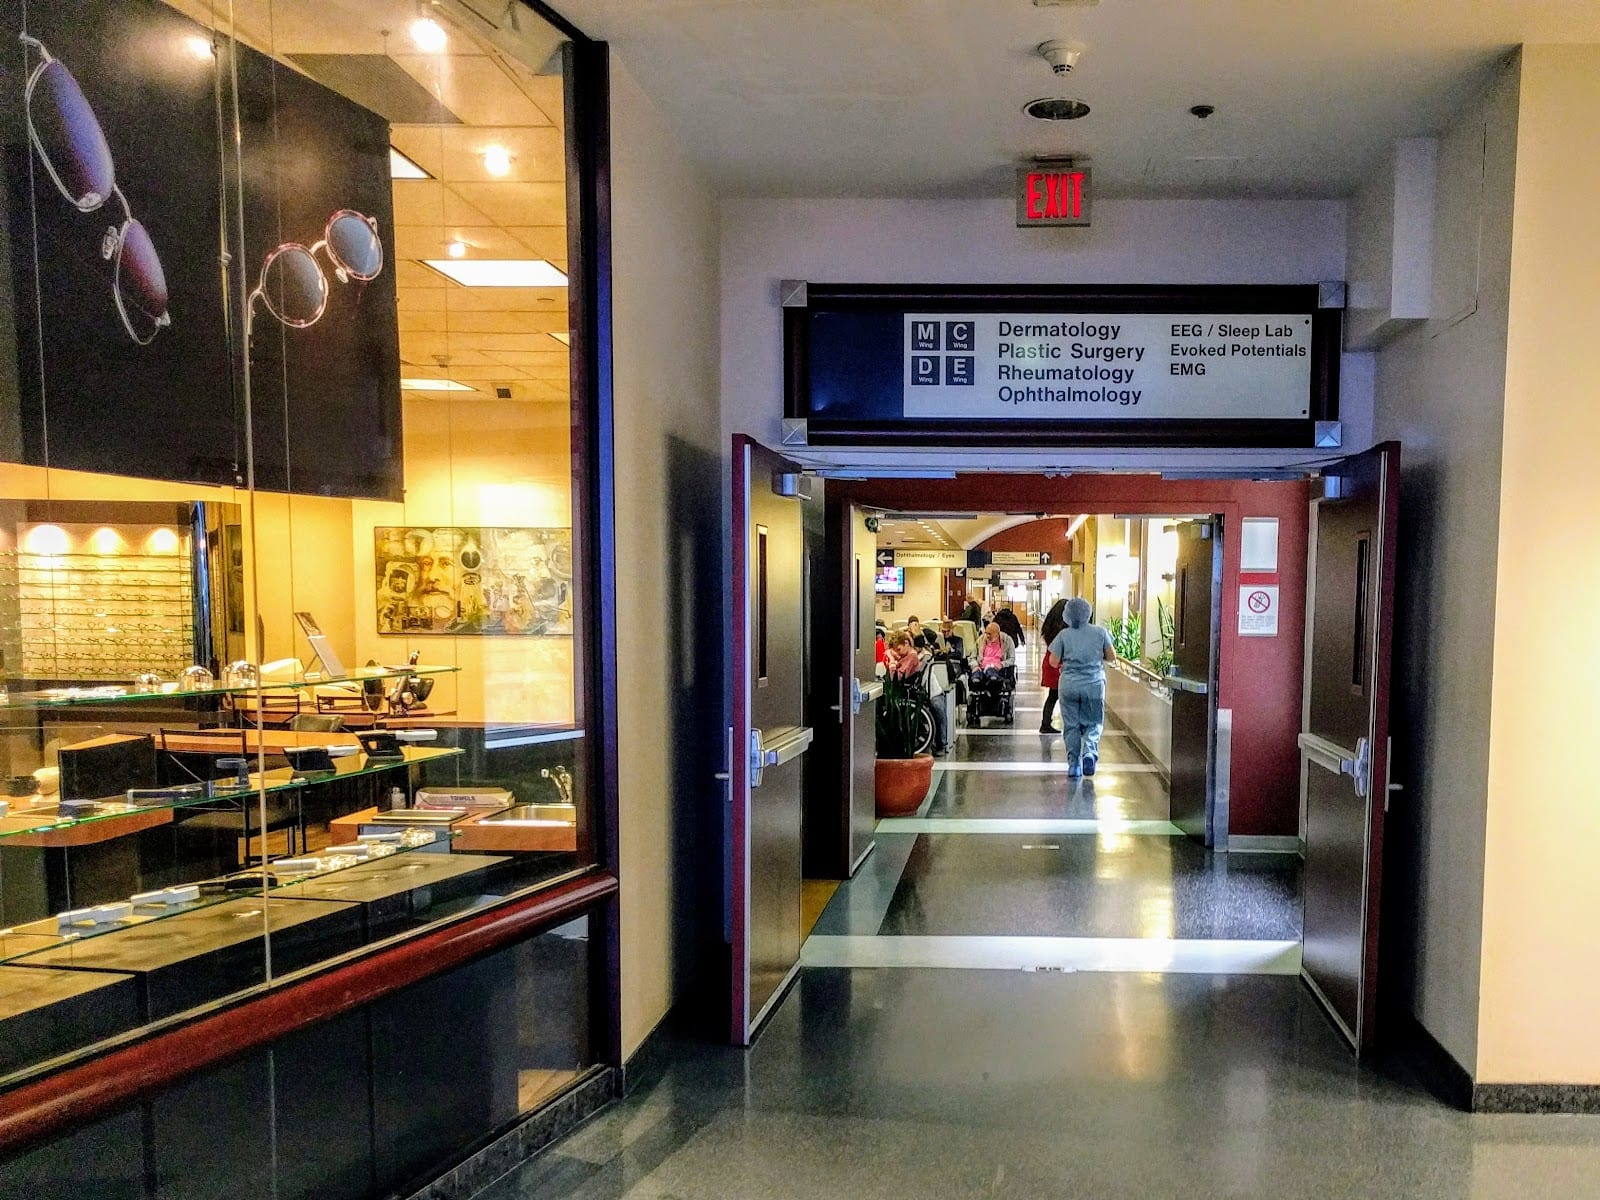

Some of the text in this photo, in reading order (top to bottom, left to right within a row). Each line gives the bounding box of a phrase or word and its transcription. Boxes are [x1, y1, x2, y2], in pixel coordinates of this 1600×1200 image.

[1026, 173, 1085, 219] EXIT
[917, 323, 934, 340] M
[953, 323, 968, 341] C
[998, 321, 1121, 341] Dermatology
[1171, 324, 1293, 340] EEG / Sleep Lab
[918, 341, 934, 349] Wing
[952, 341, 968, 349] Wing
[998, 343, 1145, 362] Plastic Surgery
[1170, 343, 1307, 357] Evoked Potentials
[918, 358, 933, 375] D
[953, 358, 967, 375] E
[998, 364, 1135, 384] Rheumatology
[1170, 363, 1206, 376] EMG
[918, 376, 934, 384] Wing
[952, 376, 968, 384] Wing
[998, 386, 1142, 406] Ophthalmology
